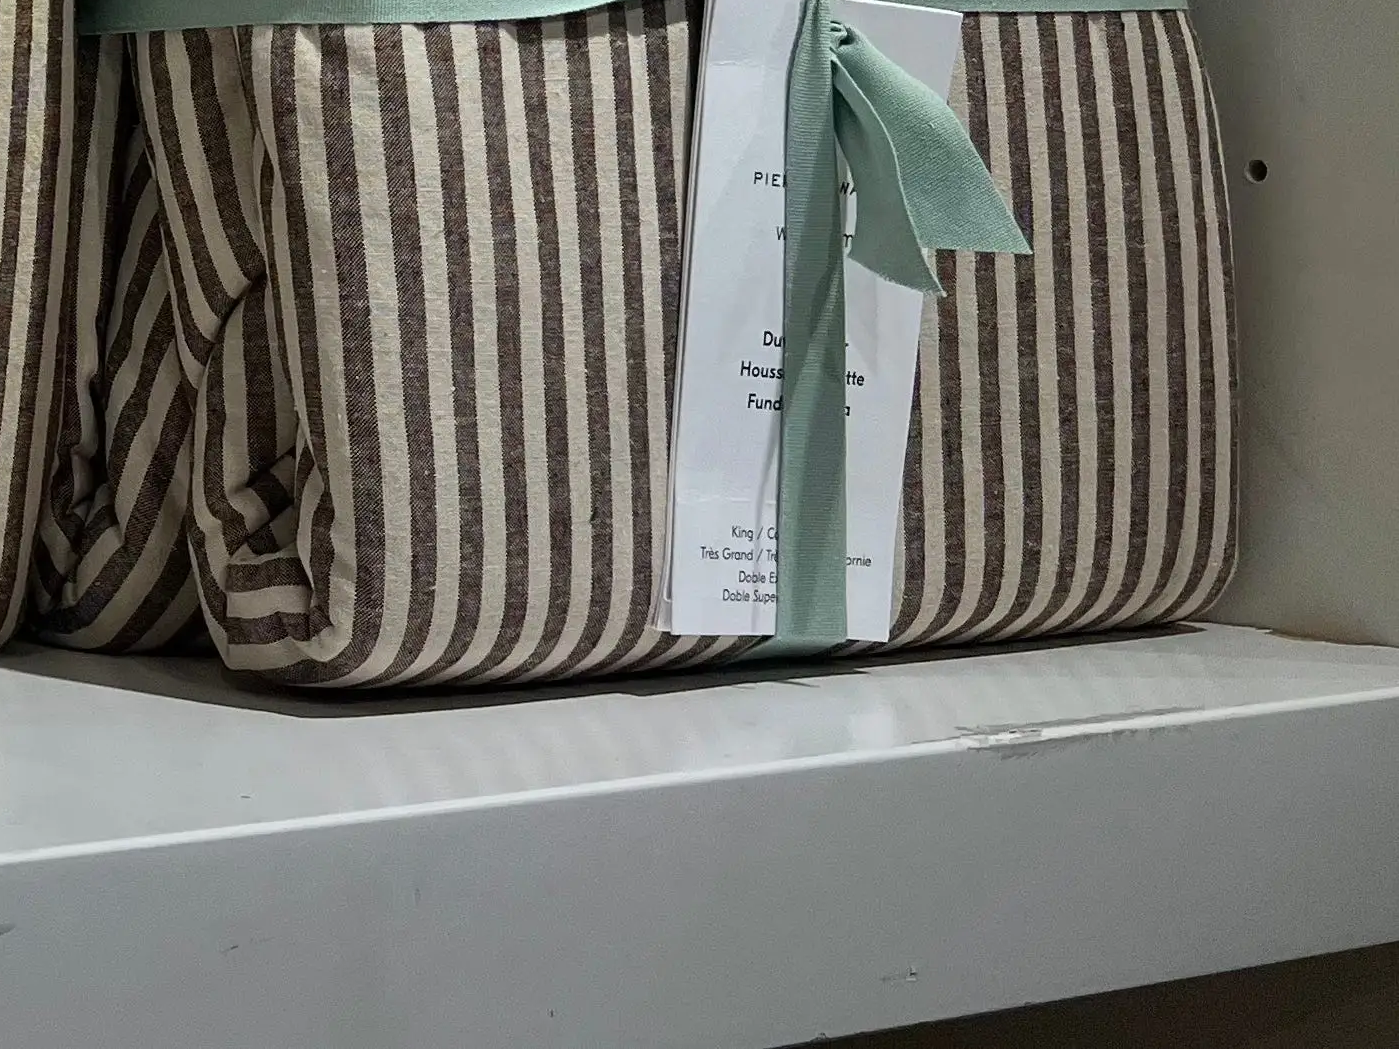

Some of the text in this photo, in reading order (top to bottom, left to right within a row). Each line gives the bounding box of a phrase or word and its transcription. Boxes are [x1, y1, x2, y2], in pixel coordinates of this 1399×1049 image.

[754, 171, 787, 188] PIE
[763, 331, 785, 349] Du
[740, 360, 865, 386] Houss tte
[747, 393, 784, 411] Fund
[731, 526, 753, 542] King
[757, 526, 763, 540] /
[700, 545, 719, 560] Très
[722, 547, 753, 561] Grand
[756, 549, 763, 562] /
[766, 549, 779, 563] Tr
[738, 570, 766, 584] Doble
[723, 588, 779, 604] Doble Supe
